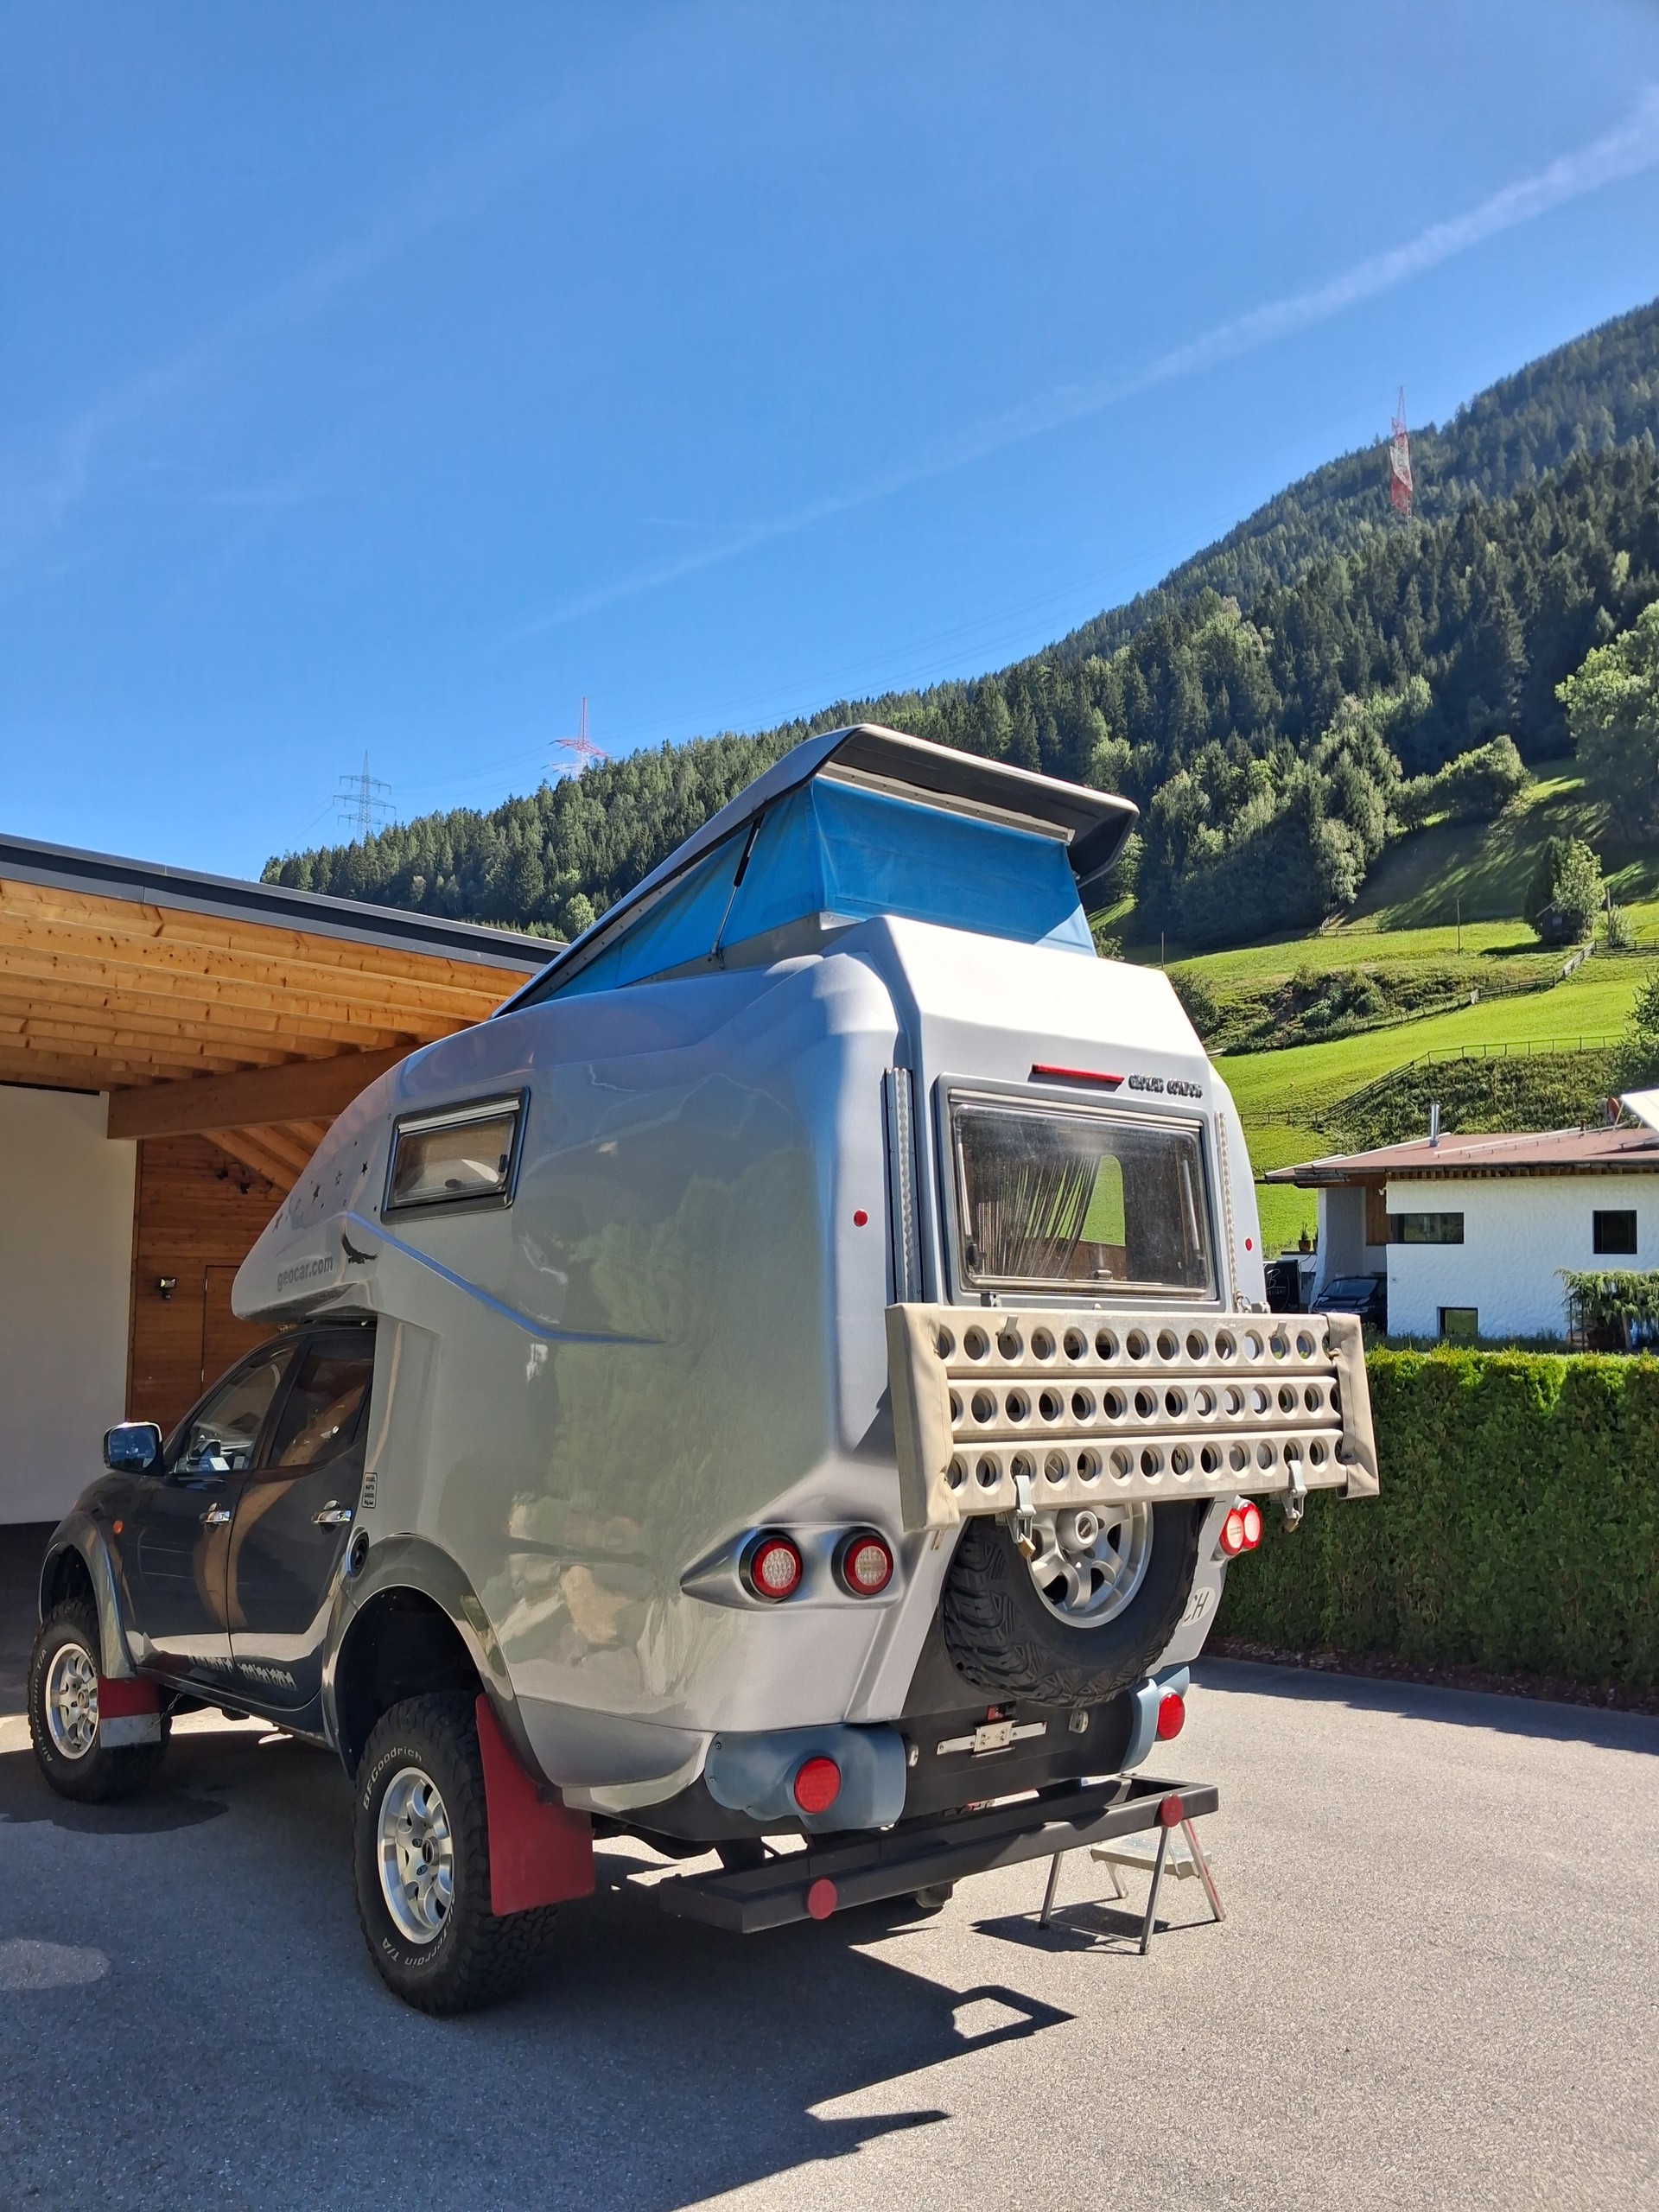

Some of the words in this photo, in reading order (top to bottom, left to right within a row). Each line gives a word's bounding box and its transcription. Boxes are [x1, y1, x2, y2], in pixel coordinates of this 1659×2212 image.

[277, 1255, 334, 1293] geocar.com
[363, 1745, 422, 1810] BFGoodrich
[382, 1937, 400, 1962] T/A
